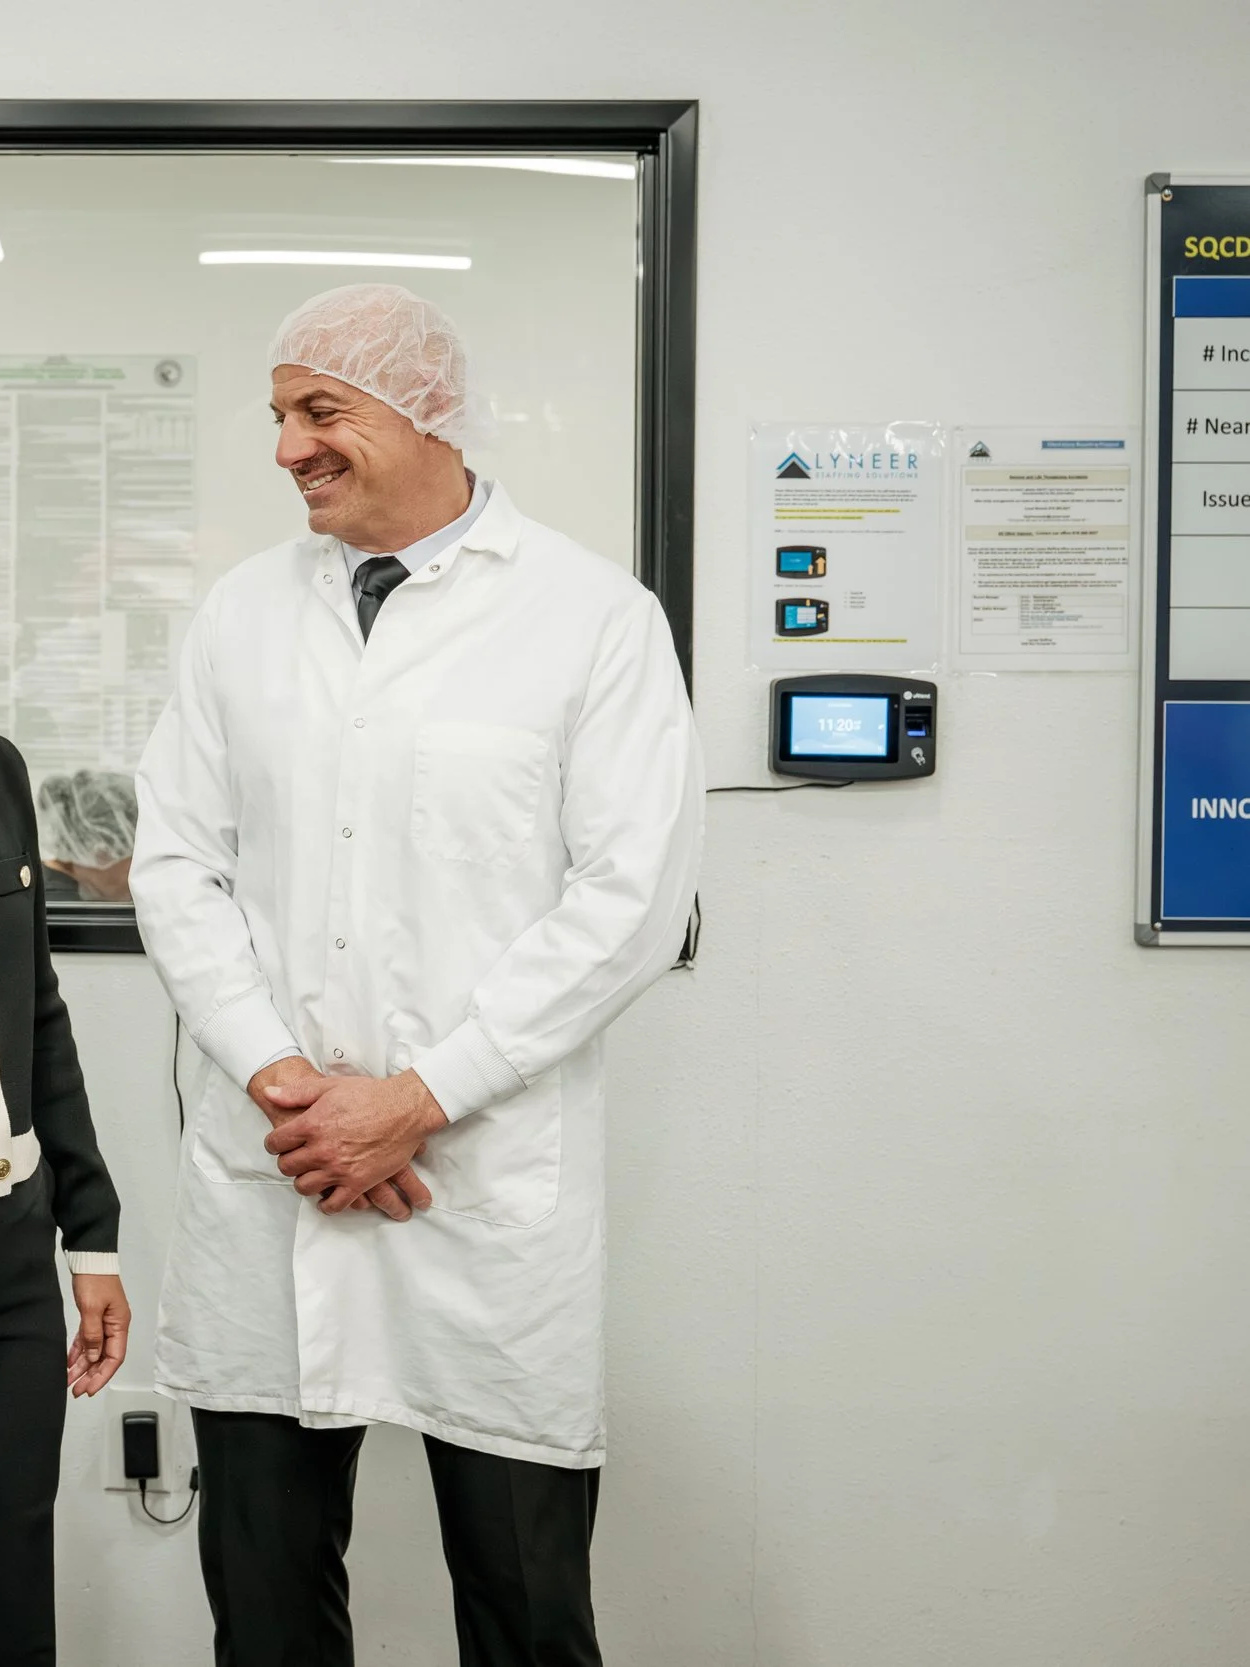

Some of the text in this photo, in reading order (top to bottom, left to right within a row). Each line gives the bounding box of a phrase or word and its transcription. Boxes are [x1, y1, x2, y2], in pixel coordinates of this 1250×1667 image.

[1184, 236, 1250, 260] SQCD
[1203, 345, 1250, 362] # Inc
[1186, 418, 1250, 435] # Near
[815, 453, 918, 469] LYNEER
[1203, 491, 1250, 508] Issue
